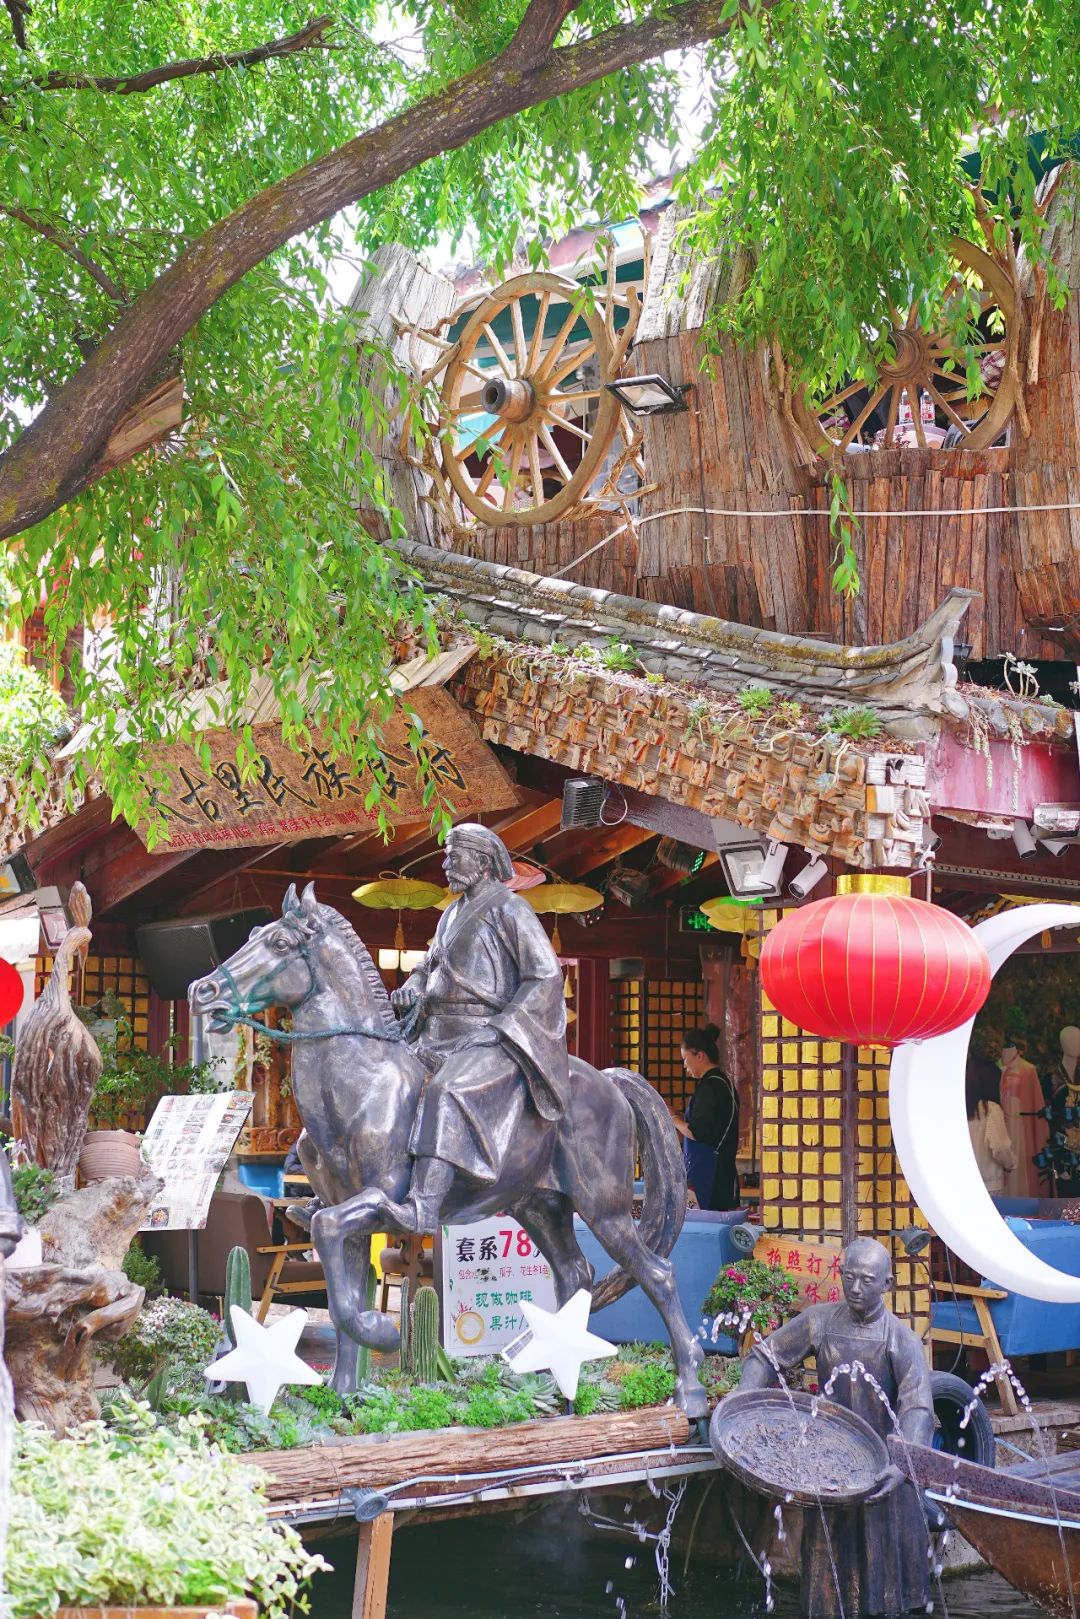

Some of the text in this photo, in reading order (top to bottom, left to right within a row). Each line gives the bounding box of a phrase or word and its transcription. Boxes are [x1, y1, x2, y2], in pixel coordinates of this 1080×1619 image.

[456, 1229, 541, 1263] 套系78
[767, 1247, 842, 1281] 拍照打卡
[475, 1290, 533, 1308] 现做咖啡
[796, 1281, 840, 1304] 休闲
[489, 1314, 530, 1331] 果汁/
